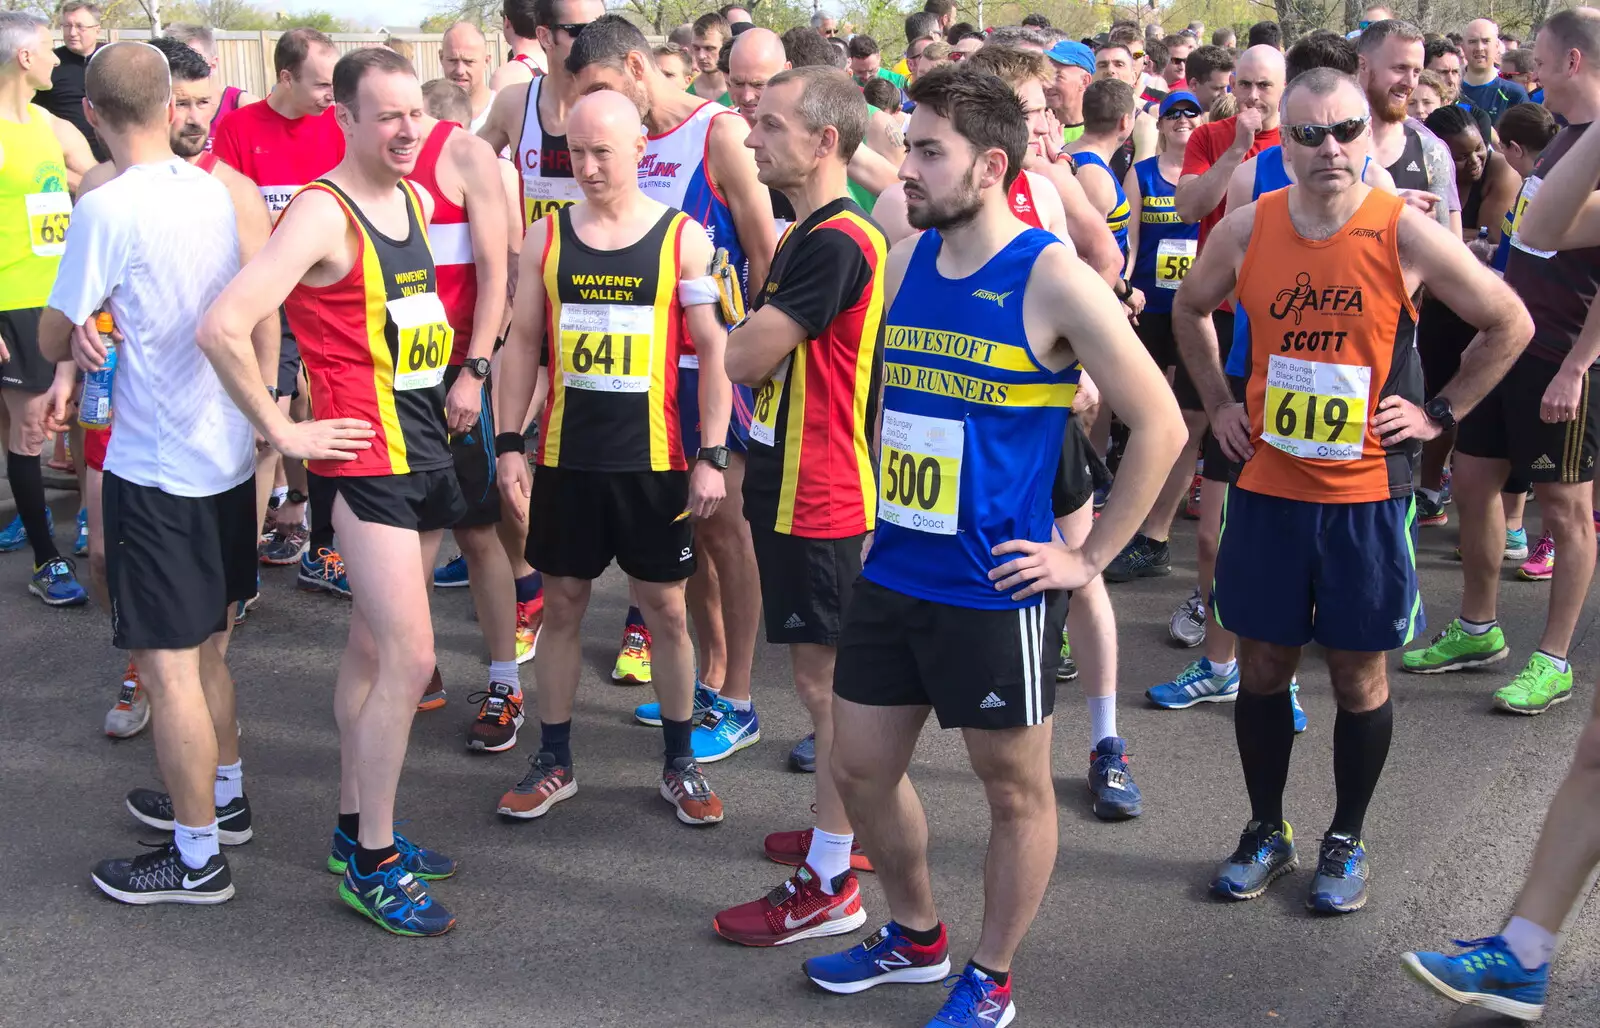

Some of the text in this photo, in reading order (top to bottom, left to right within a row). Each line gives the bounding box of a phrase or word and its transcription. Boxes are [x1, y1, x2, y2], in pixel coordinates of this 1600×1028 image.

[648, 162, 682, 178] LINK
[1144, 213, 1169, 222] ROAD
[1164, 257, 1196, 280] 58
[395, 269, 428, 285] WAVENEY
[572, 275, 643, 288] WAVENEY
[401, 283, 428, 297] VALLEY
[580, 289, 633, 301] VALLEY
[408, 323, 447, 371] 667
[886, 328, 998, 363] LOWESTOFT
[1281, 331, 1348, 352] SCOTT
[572, 333, 632, 375] 641
[1273, 361, 1317, 375] 35th Bungay
[570, 379, 596, 389] NSPCC
[1268, 379, 1316, 393] Half Marathon
[1276, 371, 1312, 386] Black Dog
[916, 369, 1009, 404] RUNNERS
[1275, 392, 1349, 442] 619
[886, 450, 941, 510] 500
[883, 510, 900, 523] NSPCC
[980, 700, 1006, 709] adidas
